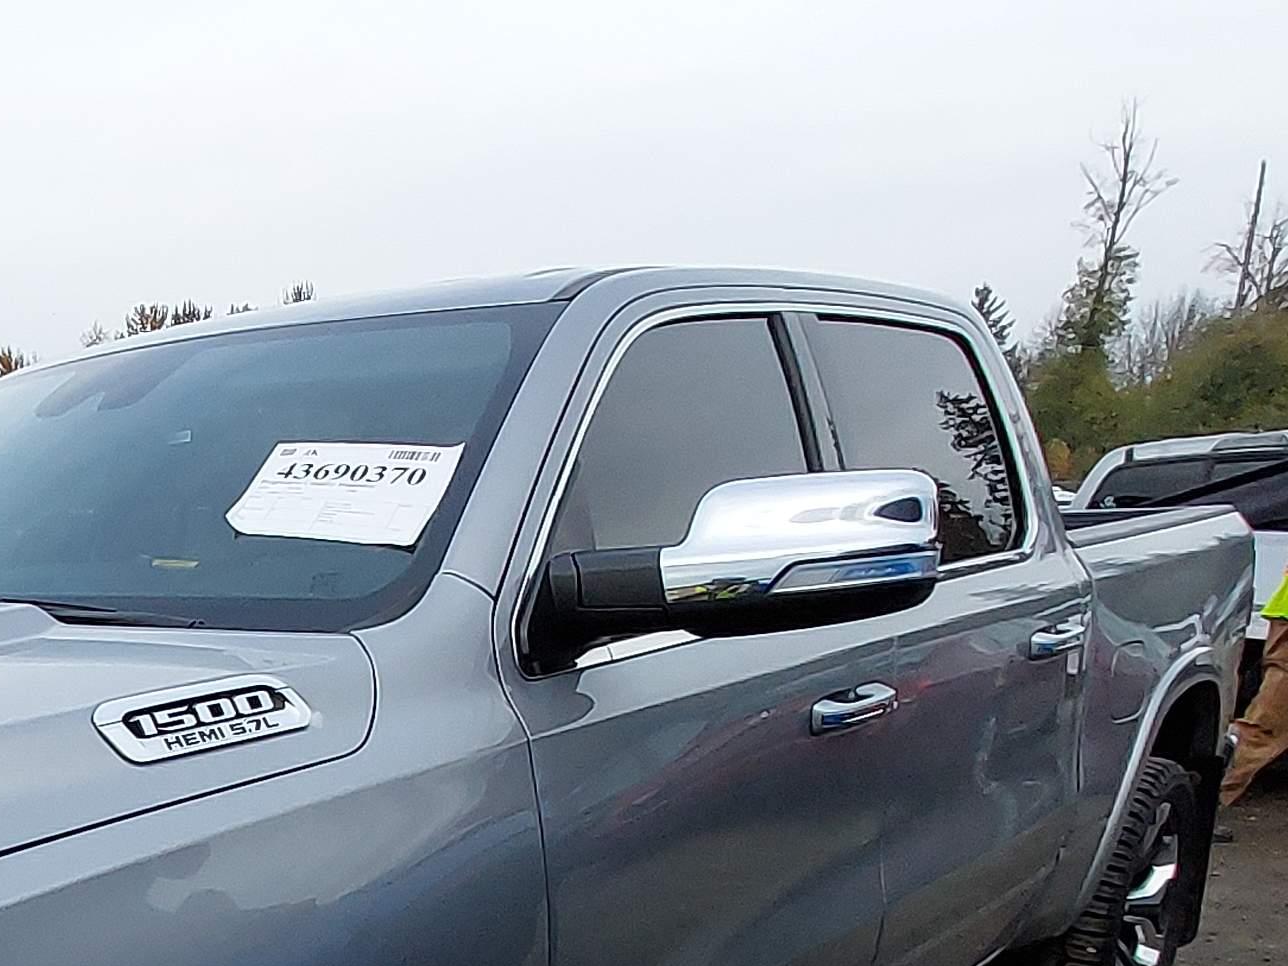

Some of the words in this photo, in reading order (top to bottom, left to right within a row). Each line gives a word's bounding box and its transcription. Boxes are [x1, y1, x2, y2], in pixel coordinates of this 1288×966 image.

[276, 462, 428, 487] 43690370
[128, 690, 275, 737] 1500
[164, 727, 227, 751] HEMI
[230, 715, 280, 737] 5.7L
